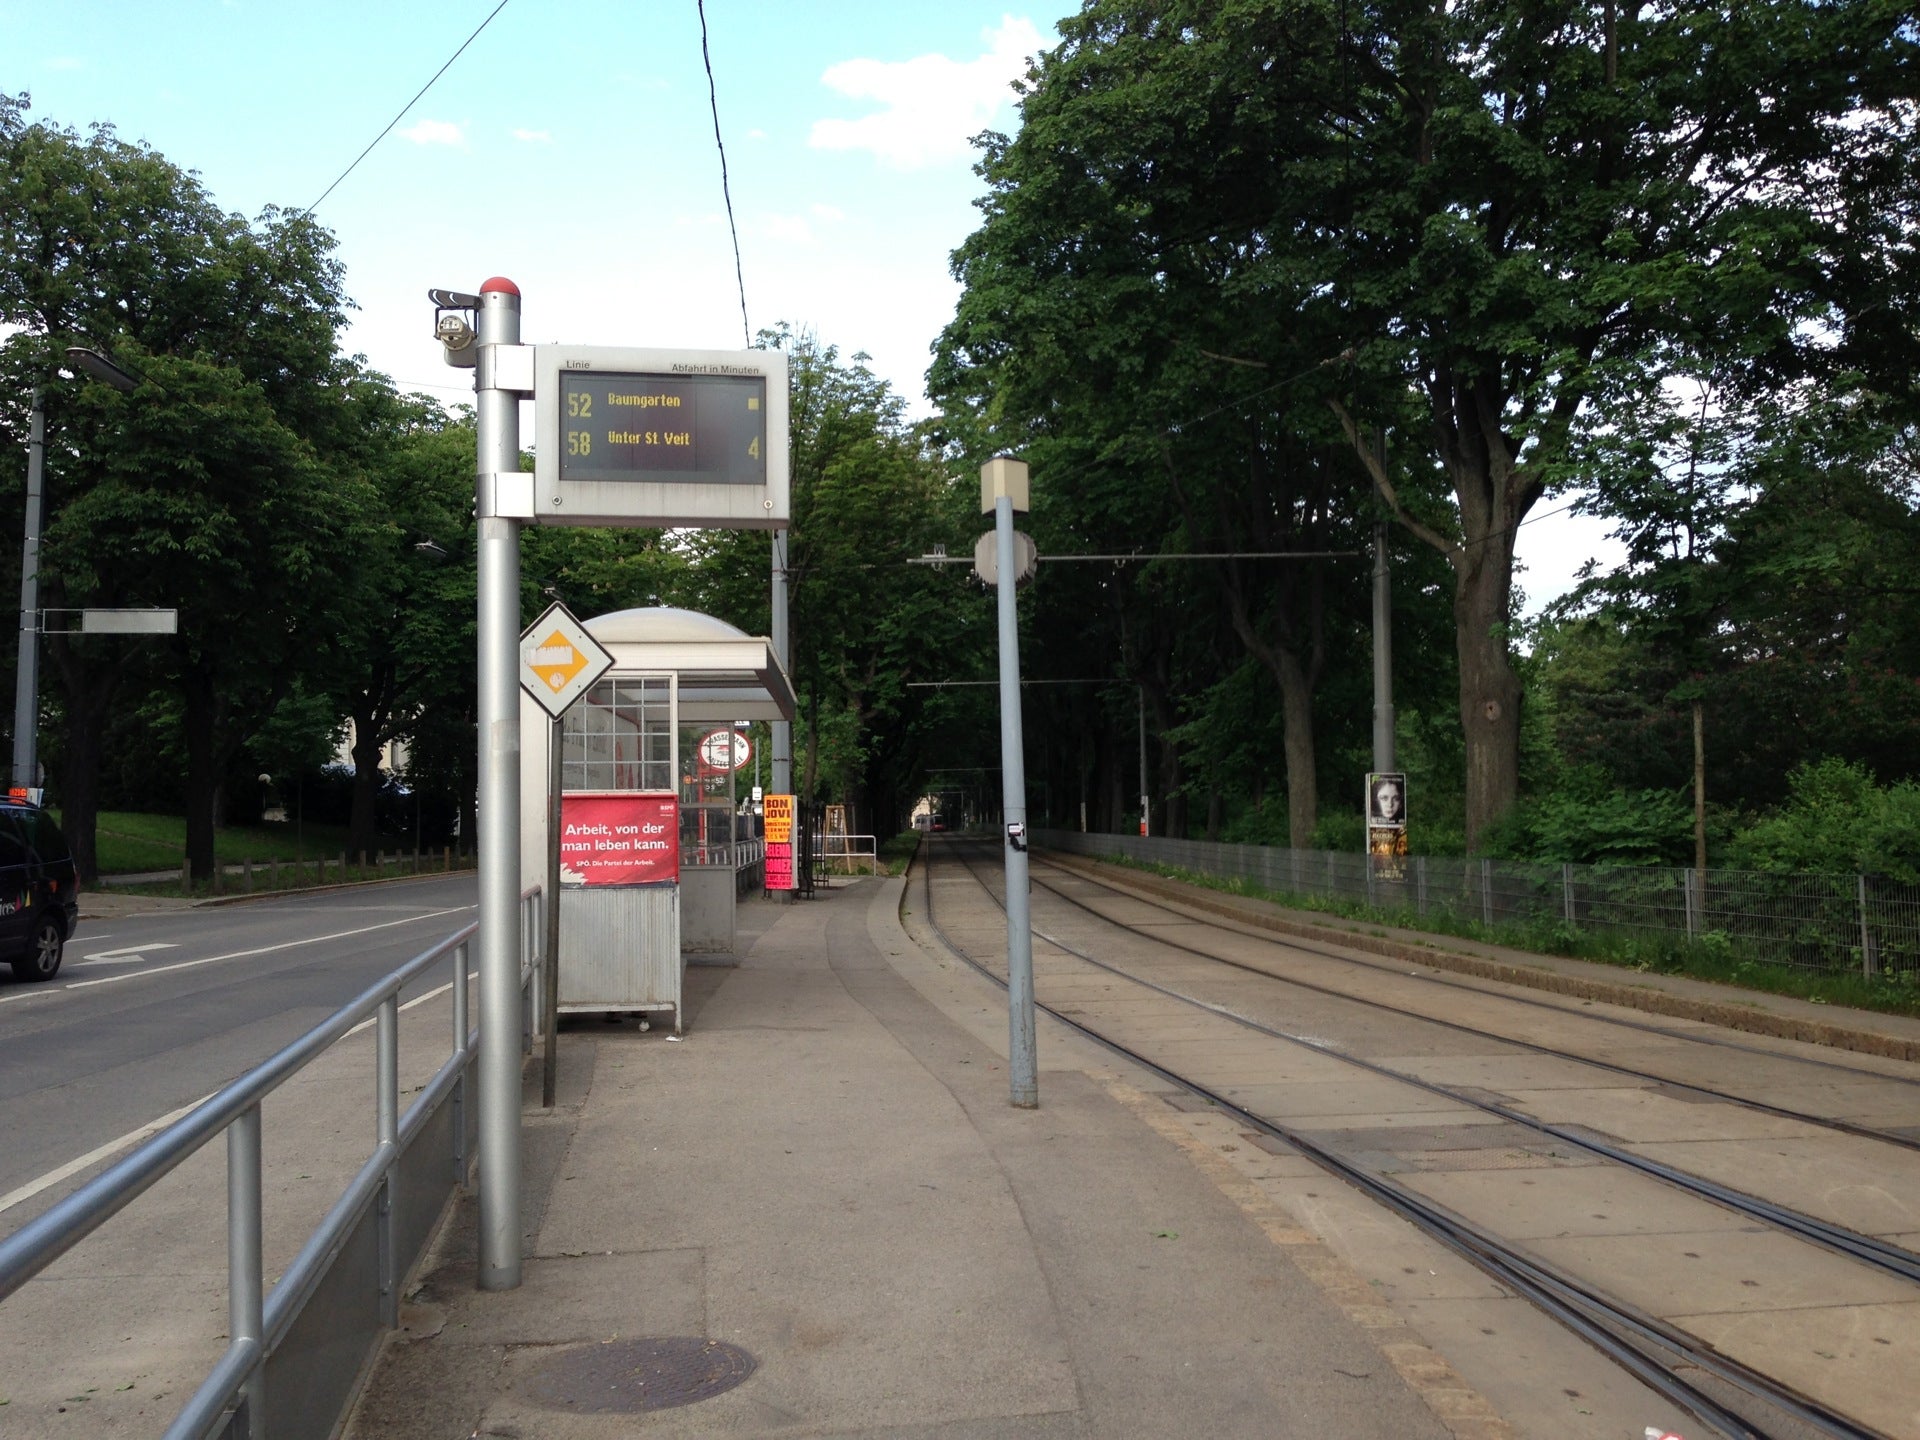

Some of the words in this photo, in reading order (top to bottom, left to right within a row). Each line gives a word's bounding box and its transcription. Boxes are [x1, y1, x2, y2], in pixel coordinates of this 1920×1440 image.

[566, 360, 590, 369] Linie
[672, 363, 707, 373] Abfahrt
[709, 365, 718, 373] in
[721, 365, 759, 375] Minuten
[568, 393, 592, 417] 52
[608, 392, 681, 408] Baumgarten
[568, 431, 591, 456] 58
[608, 431, 642, 444] Unter
[664, 432, 690, 446] Veit
[748, 436, 759, 460] 4
[766, 799, 788, 808] BON
[765, 809, 790, 818] JOVI
[565, 823, 612, 836] Arbeit,
[615, 825, 638, 834] von
[642, 822, 665, 834] der
[562, 841, 591, 851] man
[595, 839, 630, 850] leben
[634, 838, 669, 850] kann.
[576, 859, 591, 867] SPÖ.
